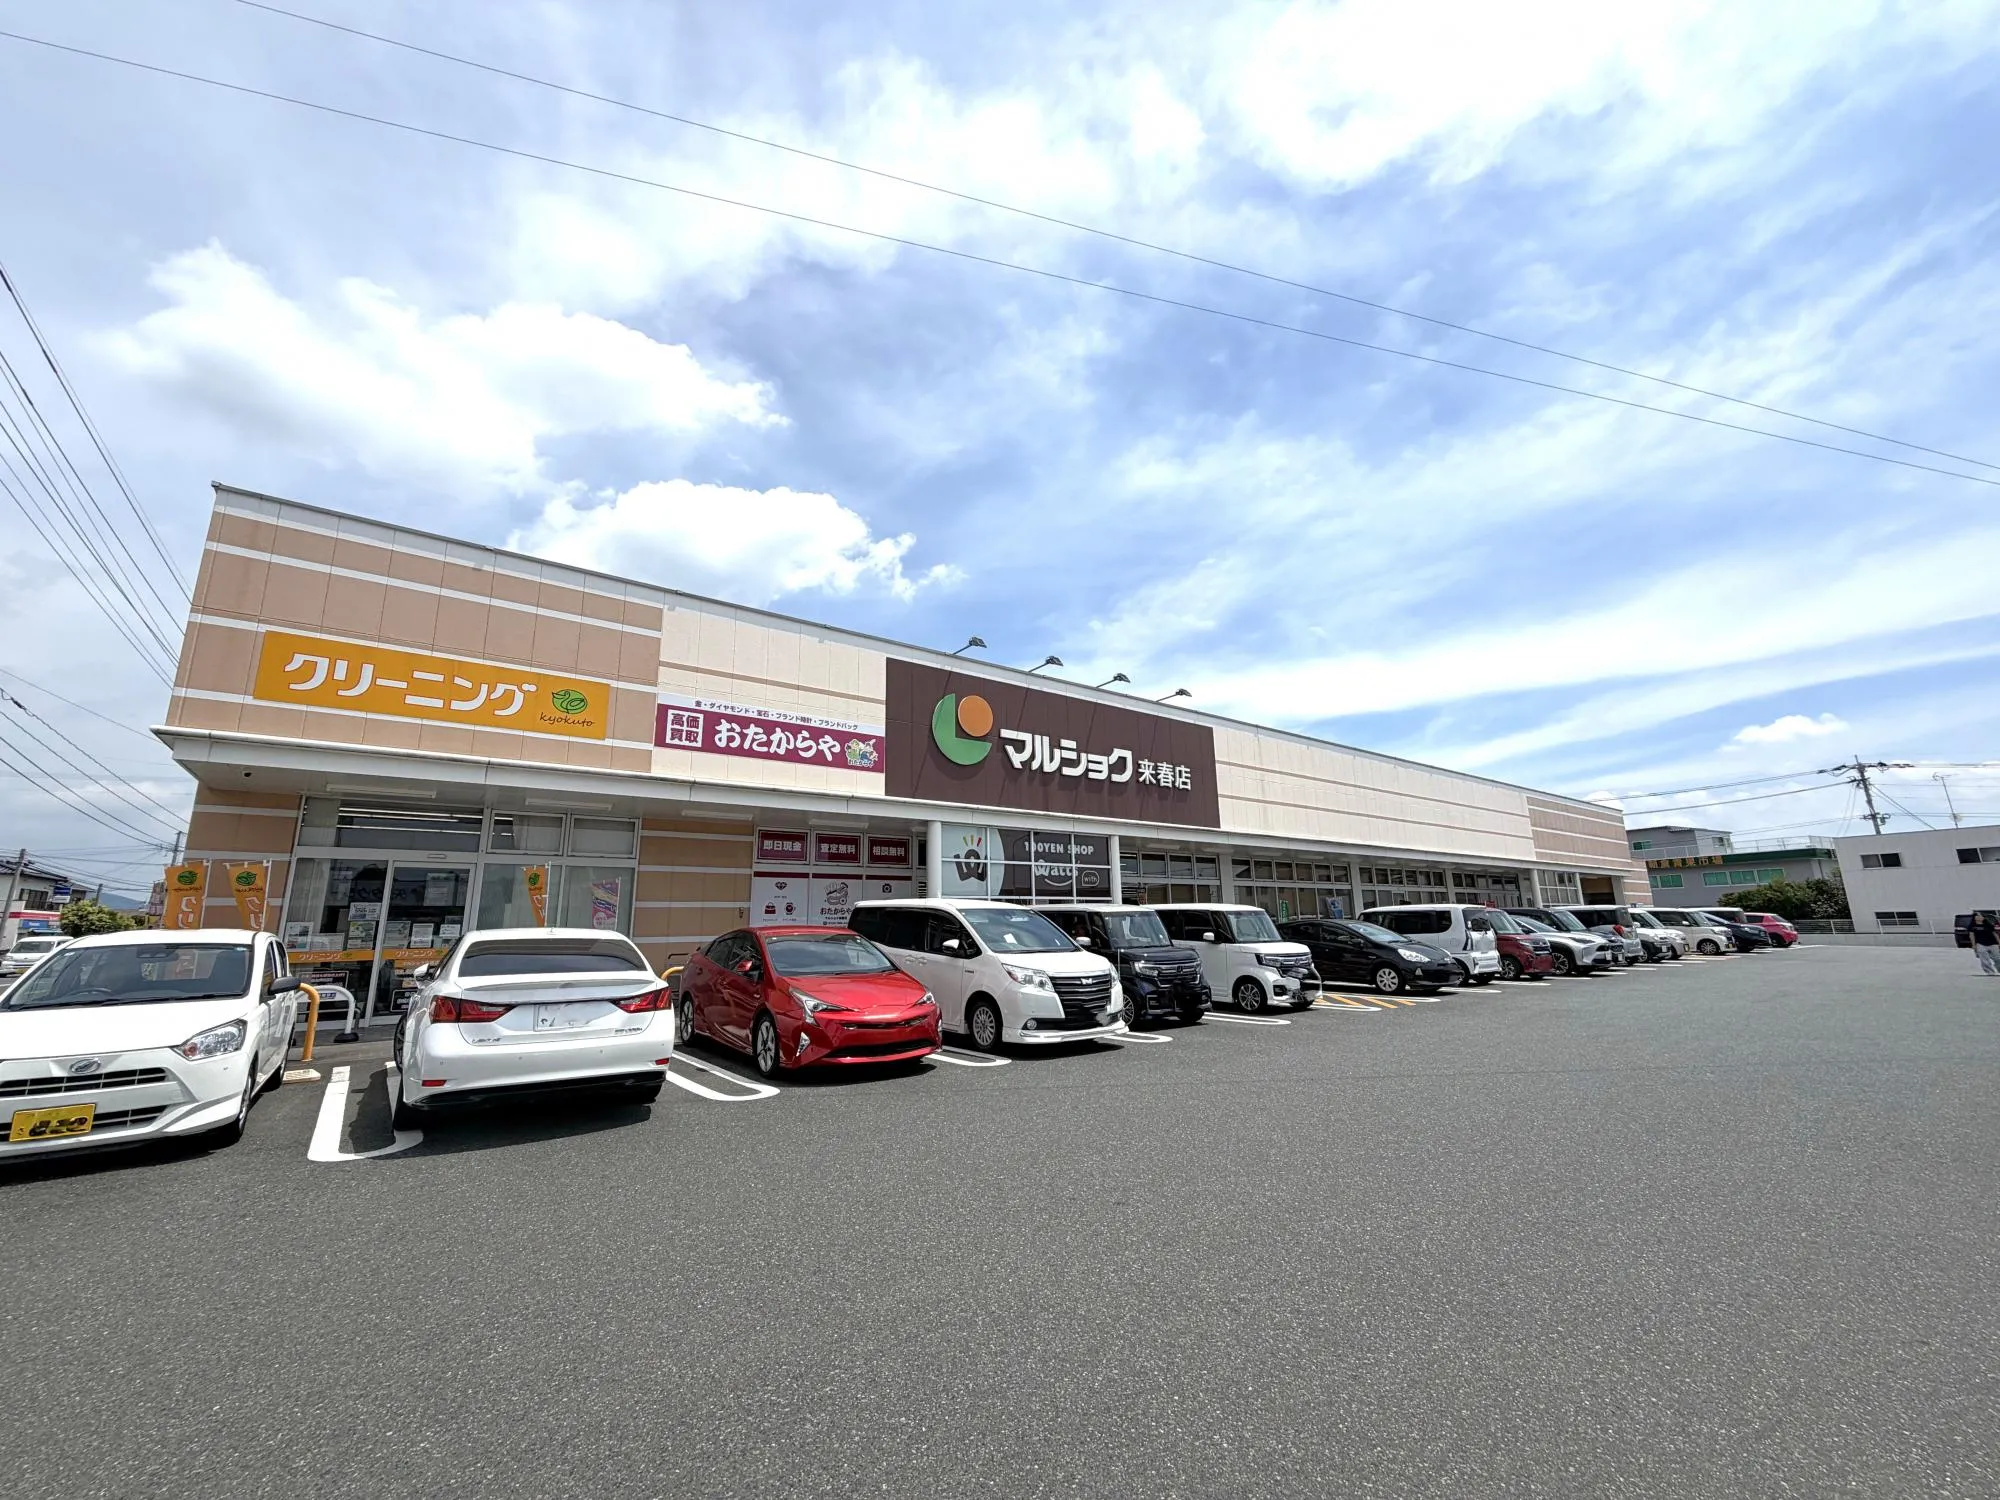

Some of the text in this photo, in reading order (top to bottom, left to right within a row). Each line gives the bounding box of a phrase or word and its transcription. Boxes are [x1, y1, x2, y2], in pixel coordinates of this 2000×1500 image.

[284, 652, 537, 716] クリーニング
[539, 711, 596, 728] kyokuto
[670, 713, 700, 729] 高価
[669, 727, 699, 744] 買取
[714, 718, 841, 761] おたからや
[1000, 728, 1134, 783] マルショク
[1138, 758, 1192, 790] 来春店
[763, 839, 802, 852] 即日現金
[820, 843, 856, 855] 査定無料
[872, 846, 905, 857] 相談無料
[1084, 874, 1098, 883] with
[299, 952, 342, 960] クリーニング
[395, 950, 433, 958] クリーニング
